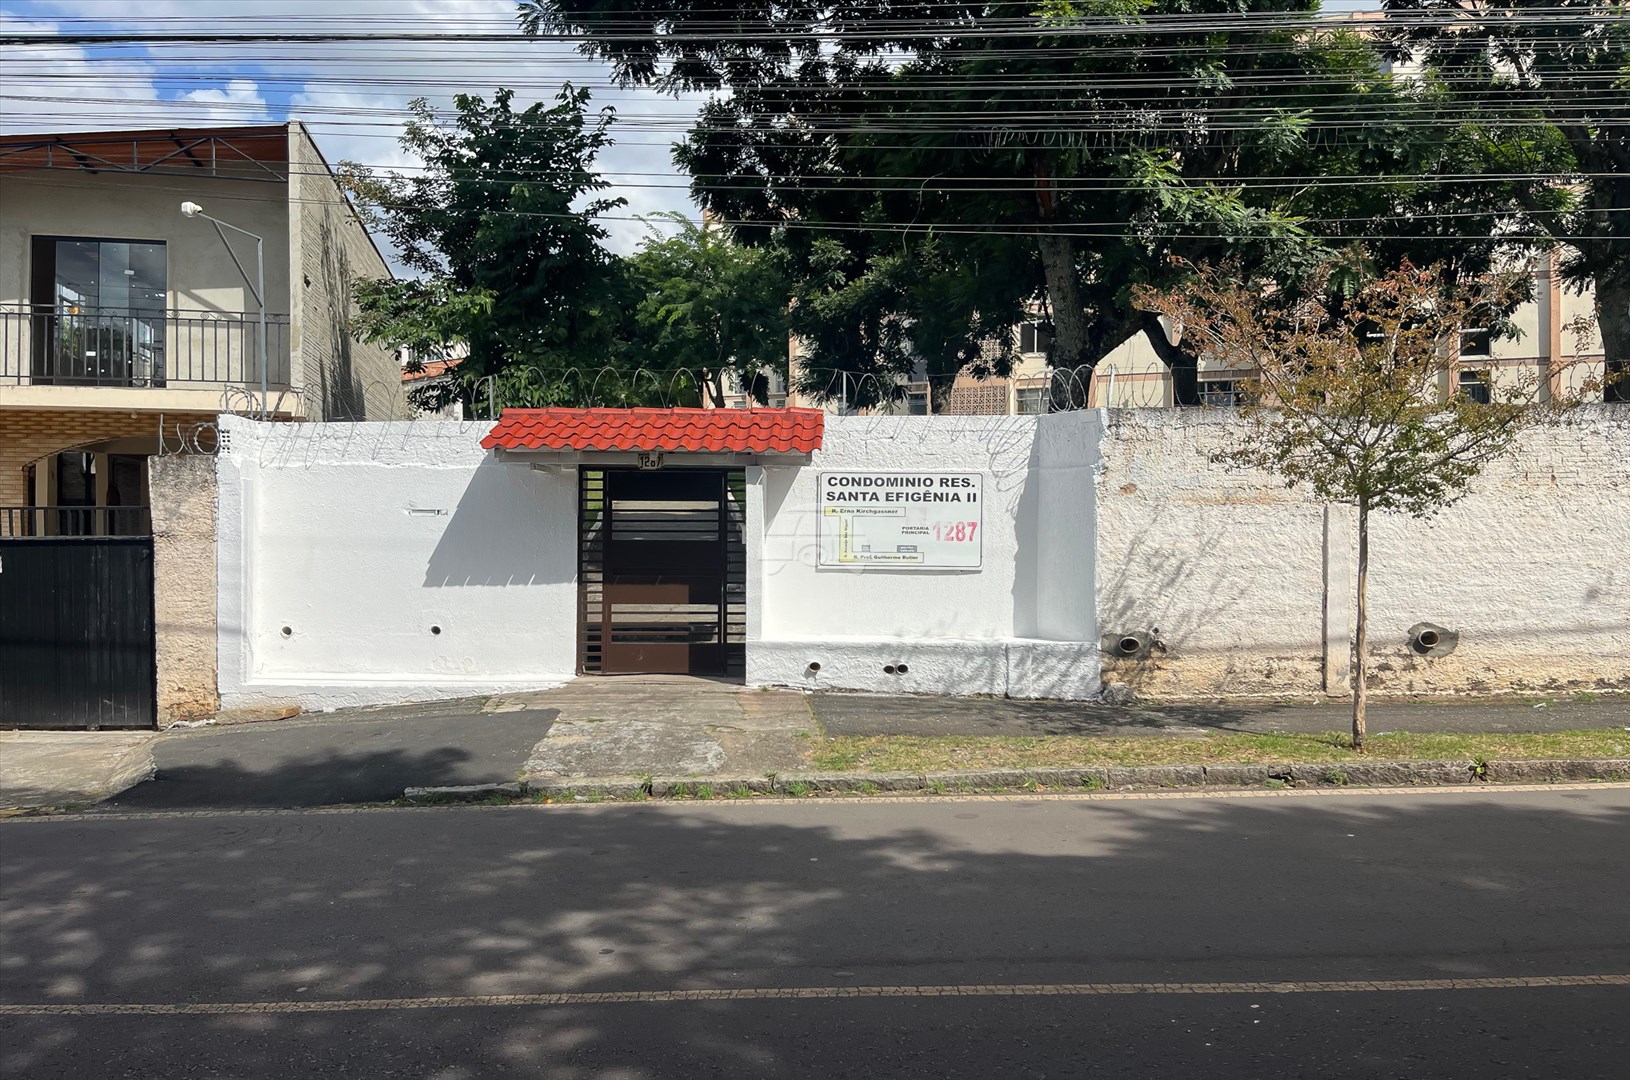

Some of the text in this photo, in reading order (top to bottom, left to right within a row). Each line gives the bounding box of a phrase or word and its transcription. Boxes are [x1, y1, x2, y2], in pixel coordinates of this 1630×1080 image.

[640, 456, 661, 468] 1287
[827, 476, 976, 488] CONDOMINIO RES.
[826, 490, 977, 503] SANTA EFIGÊNIA II
[932, 521, 978, 542] 1287
